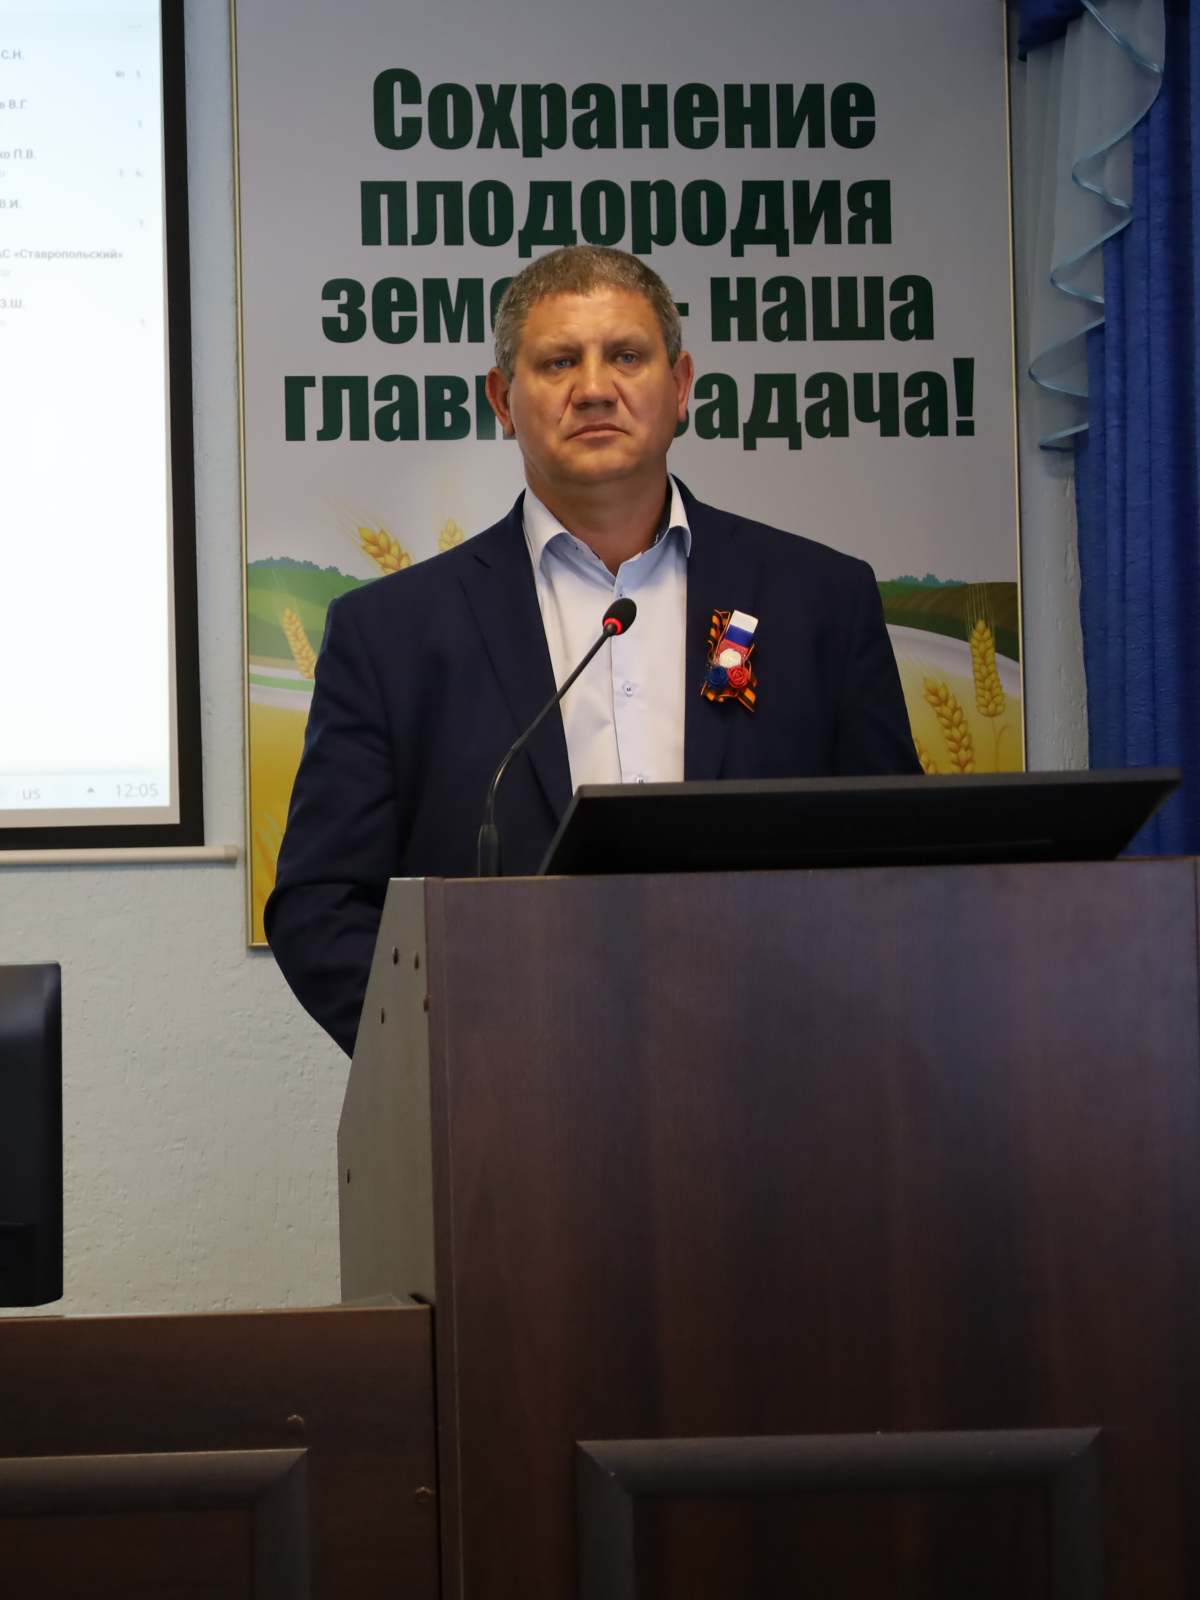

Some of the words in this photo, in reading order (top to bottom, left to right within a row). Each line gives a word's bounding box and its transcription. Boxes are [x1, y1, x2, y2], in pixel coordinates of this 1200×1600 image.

[1, 50, 25, 60] С.Н.
[8, 100, 27, 110] В.Г.
[372, 67, 876, 158] Сохранение
[14, 149, 37, 160] П.В.
[360, 178, 892, 259] плодородия
[14, 248, 123, 262] «Ставропольский»
[709, 274, 935, 343] наша
[22, 788, 41, 800] us
[114, 783, 158, 799] 12:05
